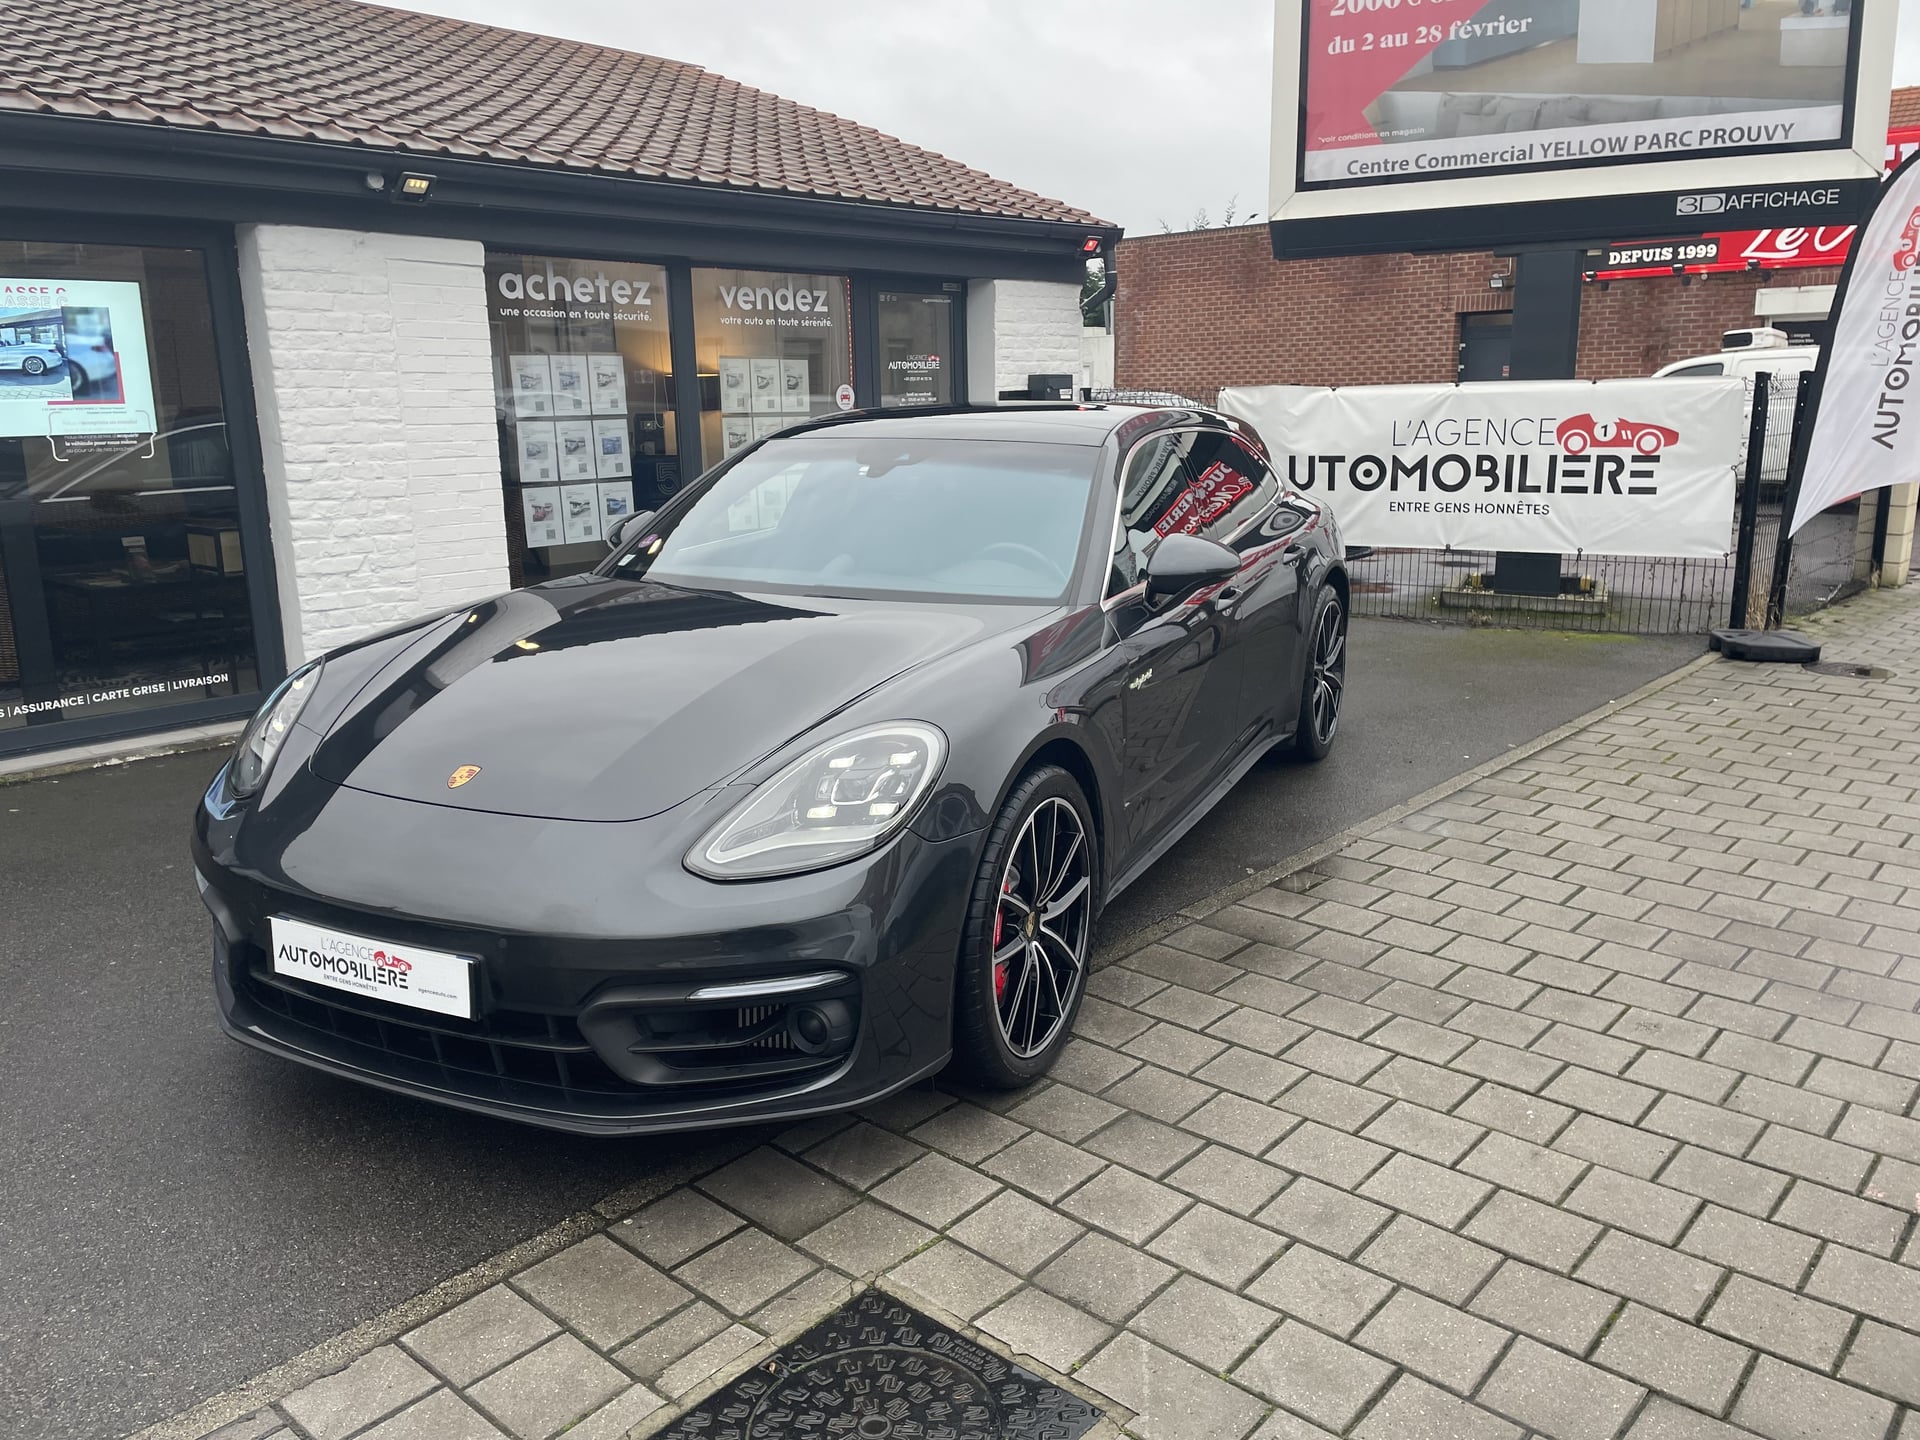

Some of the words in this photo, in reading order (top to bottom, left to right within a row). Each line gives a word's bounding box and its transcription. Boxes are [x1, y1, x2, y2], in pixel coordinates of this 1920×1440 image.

[1327, 35, 1355, 55] du
[1361, 32, 1374, 50] 2
[1379, 31, 1408, 48] au
[1415, 25, 1442, 44] 28
[1449, 15, 1532, 41] février
[1338, 130, 1378, 142] conditions
[1380, 130, 1390, 138] en
[1392, 127, 1425, 139] magasin
[1346, 157, 1409, 176] Centre
[1414, 143, 1533, 170] Commercial
[1540, 135, 1629, 159] YELLOW
[1634, 130, 1692, 150] PARC
[1699, 122, 1795, 146] PROUVY
[1608, 246, 1673, 265] DEPUIS
[1678, 243, 1717, 260] 1999
[498, 264, 651, 305] achetez
[719, 279, 829, 312] vendez
[500, 307, 520, 317] une
[523, 307, 566, 319] occasion
[569, 310, 582, 319] en
[584, 309, 610, 320] toute
[613, 310, 652, 321] sécurité.
[720, 316, 741, 325] votre
[744, 316, 764, 326] auto
[766, 318, 775, 326] en
[778, 317, 799, 327] toute
[801, 316, 833, 327] sérénité.
[1870, 271, 1907, 367] L'AGENCE
[1392, 416, 1557, 447] L'AGENCE
[1289, 454, 1661, 496] UTOMOBILIERE
[1389, 501, 1430, 513] ENTRE
[1434, 502, 1471, 514] GENS
[1474, 500, 1550, 516] HONNÊTES
[13, 695, 85, 716] ASSURANCE
[92, 687, 130, 703] CARTE
[132, 682, 166, 697] GRISE
[173, 672, 229, 690] LIVRAISON
[320, 937, 374, 961] L'AGENCE
[324, 973, 338, 983] ENTRE
[338, 977, 351, 986] GENS
